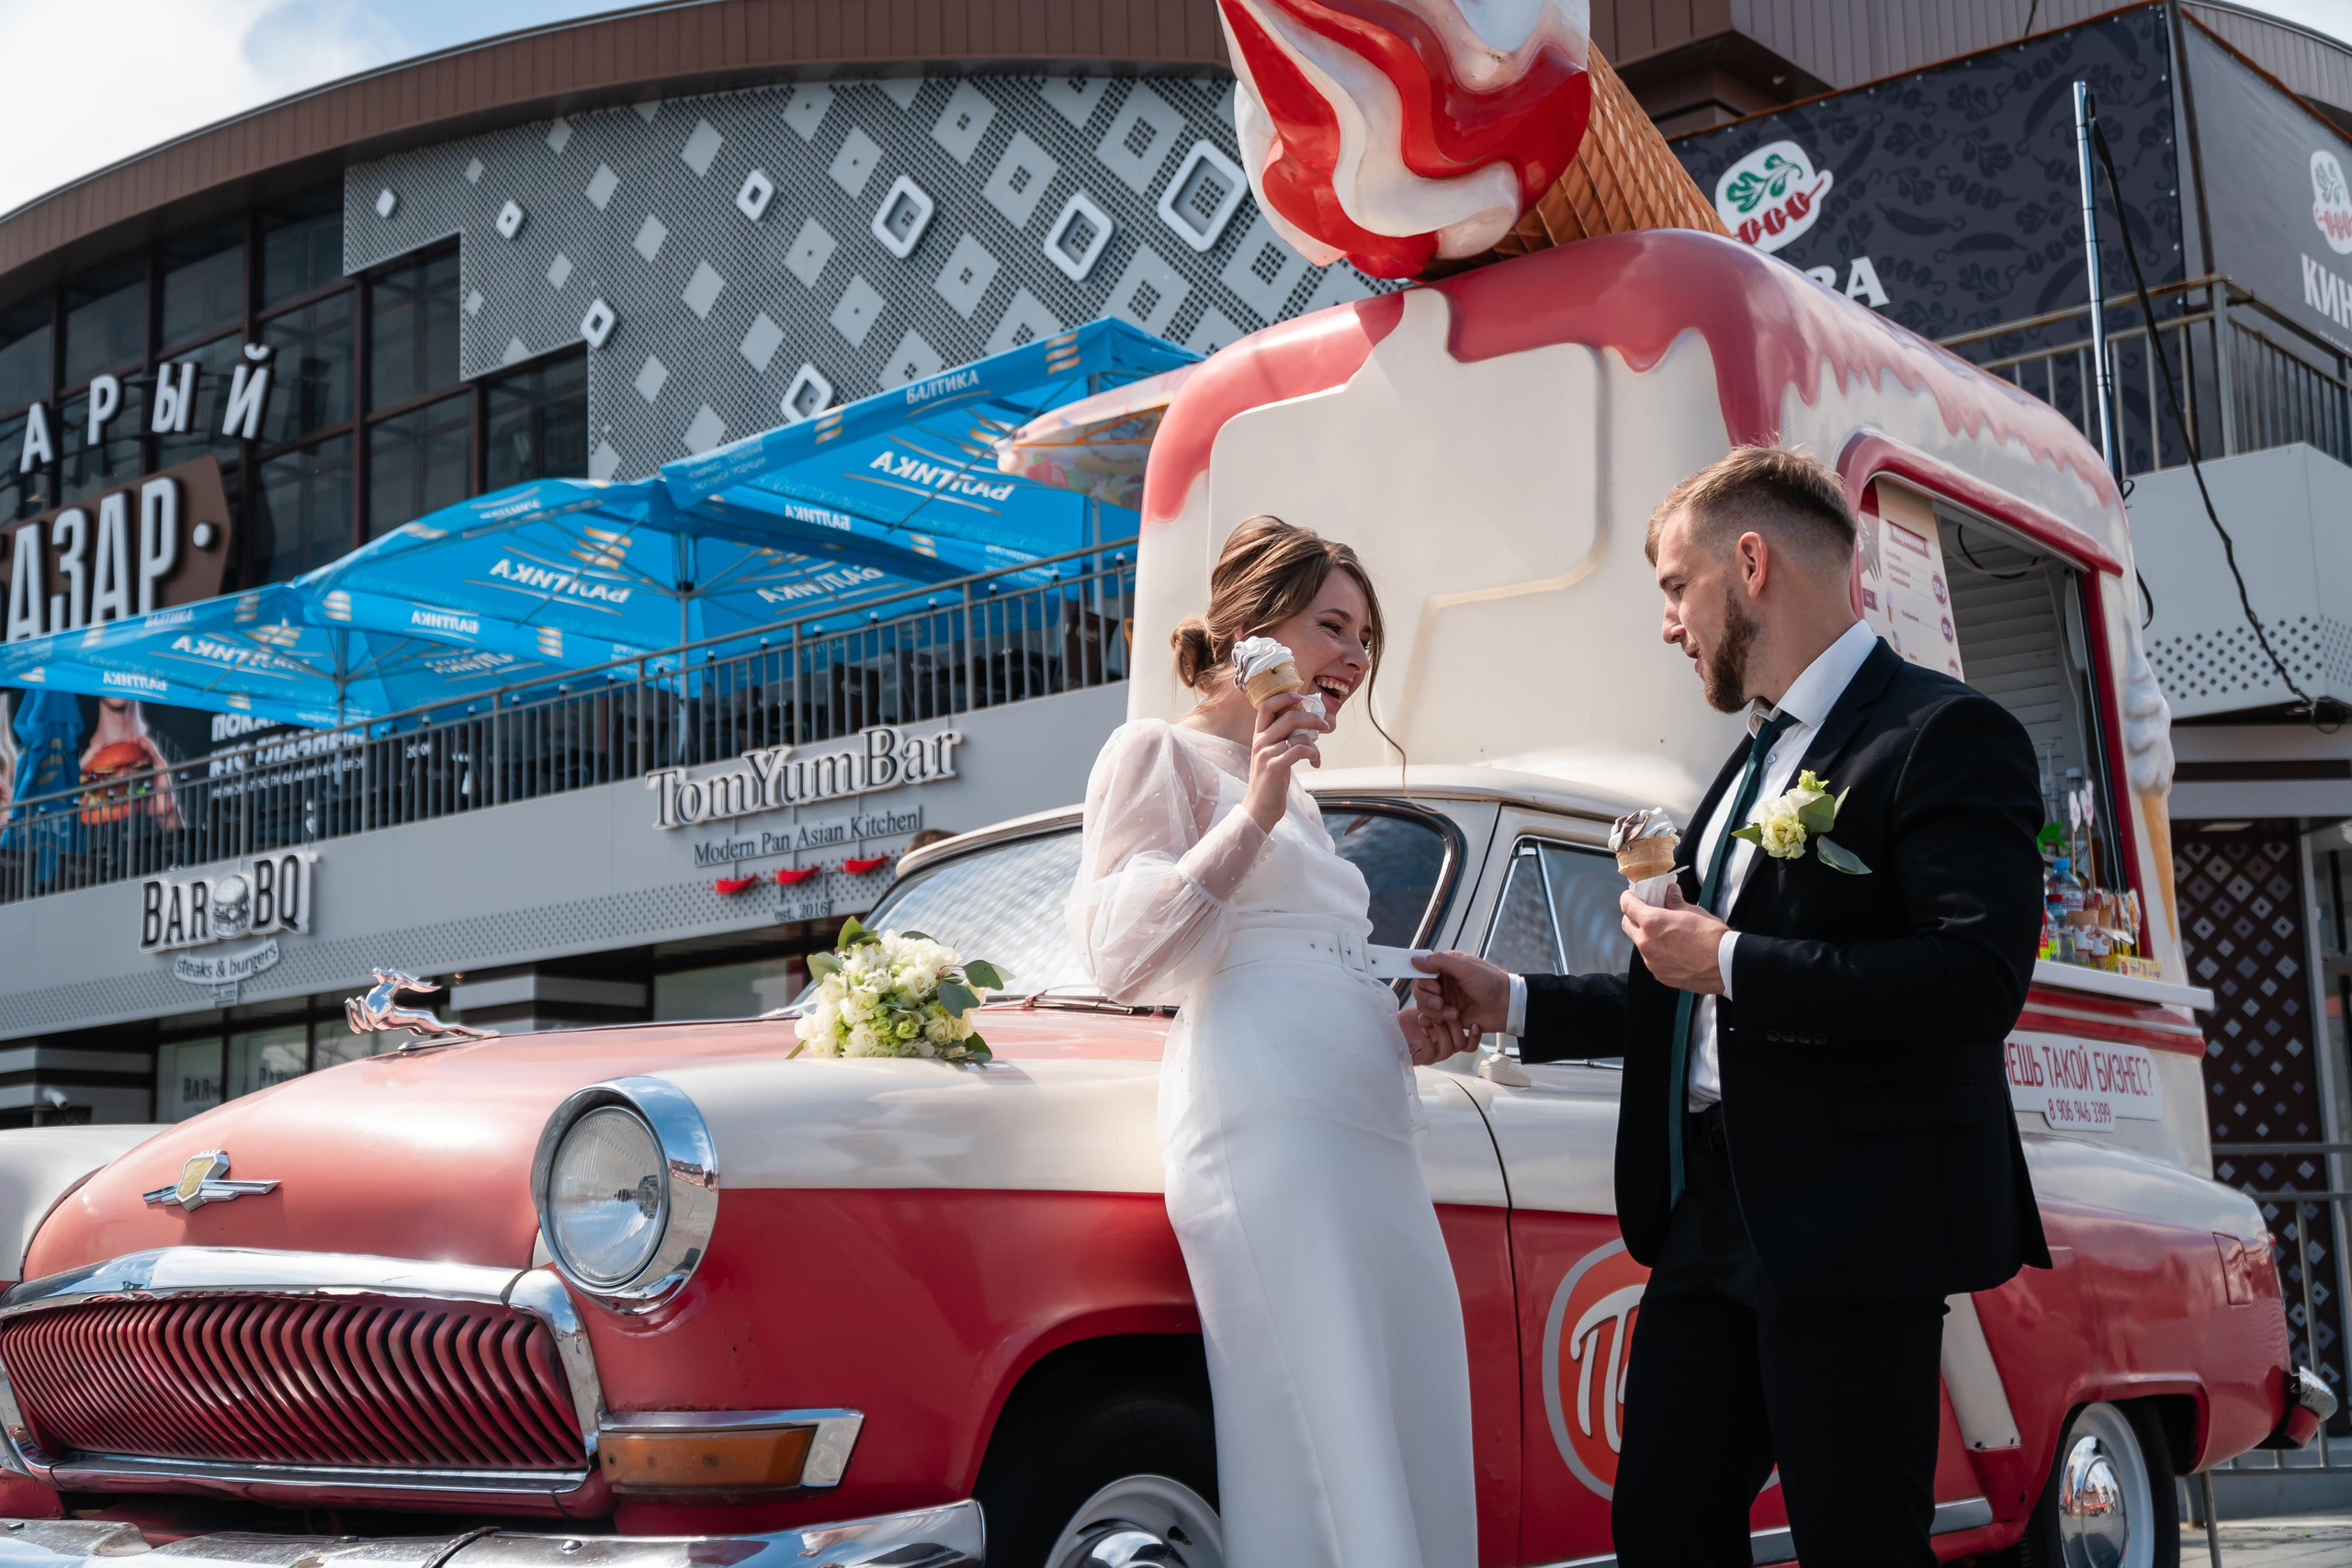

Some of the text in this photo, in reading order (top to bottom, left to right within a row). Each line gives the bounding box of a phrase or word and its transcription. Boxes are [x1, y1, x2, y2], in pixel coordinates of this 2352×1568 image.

[905, 369, 979, 404] БАЛТИКА
[2, 476, 180, 643] АЗАР
[646, 728, 960, 829] TomYumBar
[694, 810, 918, 865] Modern Pan Asian Kitchen
[141, 854, 301, 951] BAR BQ
[175, 945, 277, 979] steaks & burgers
[2041, 1044, 2094, 1091] ТАКОЙ
[2093, 1052, 2154, 1098] БИЗНЕС?
[2048, 1099, 2111, 1123] 8 906 946 3399
